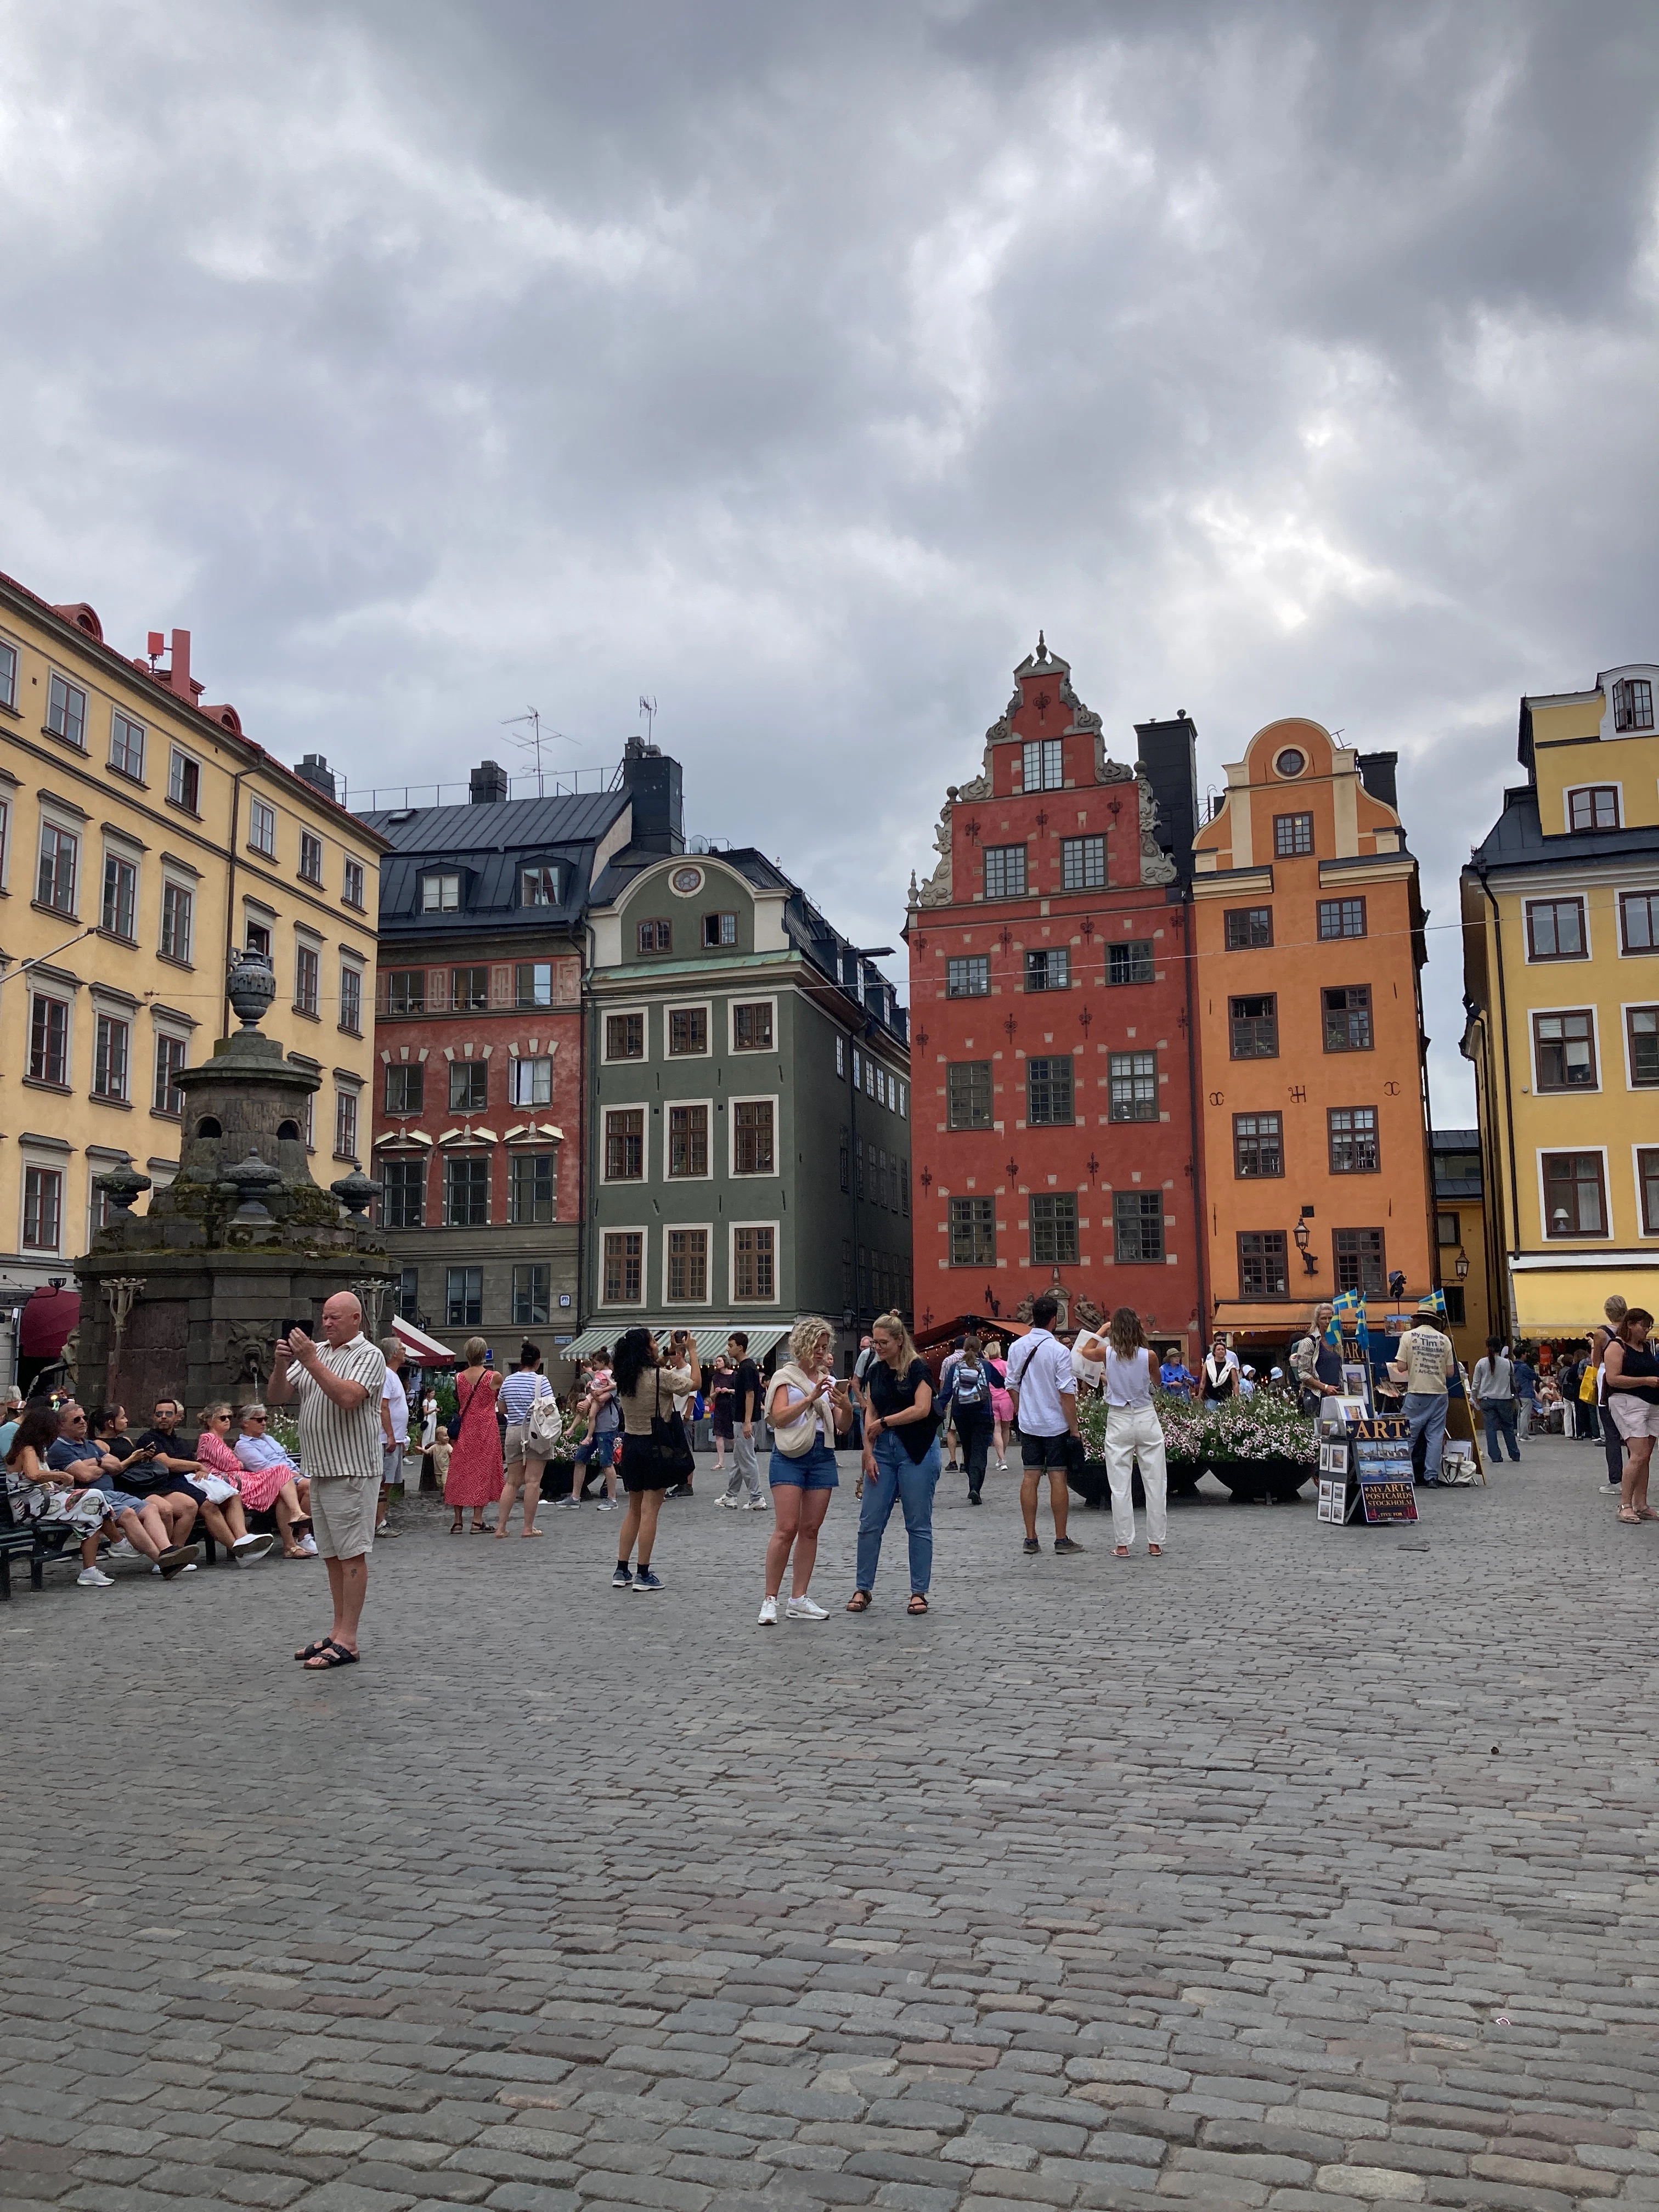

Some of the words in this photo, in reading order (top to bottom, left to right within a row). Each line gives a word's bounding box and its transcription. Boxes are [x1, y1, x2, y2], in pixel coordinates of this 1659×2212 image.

[1420, 1338, 1437, 1347] Tim
[1354, 1419, 1405, 1439] ART
[1384, 1483, 1406, 1492] ART
[1365, 1492, 1413, 1500] POSTCARDS
